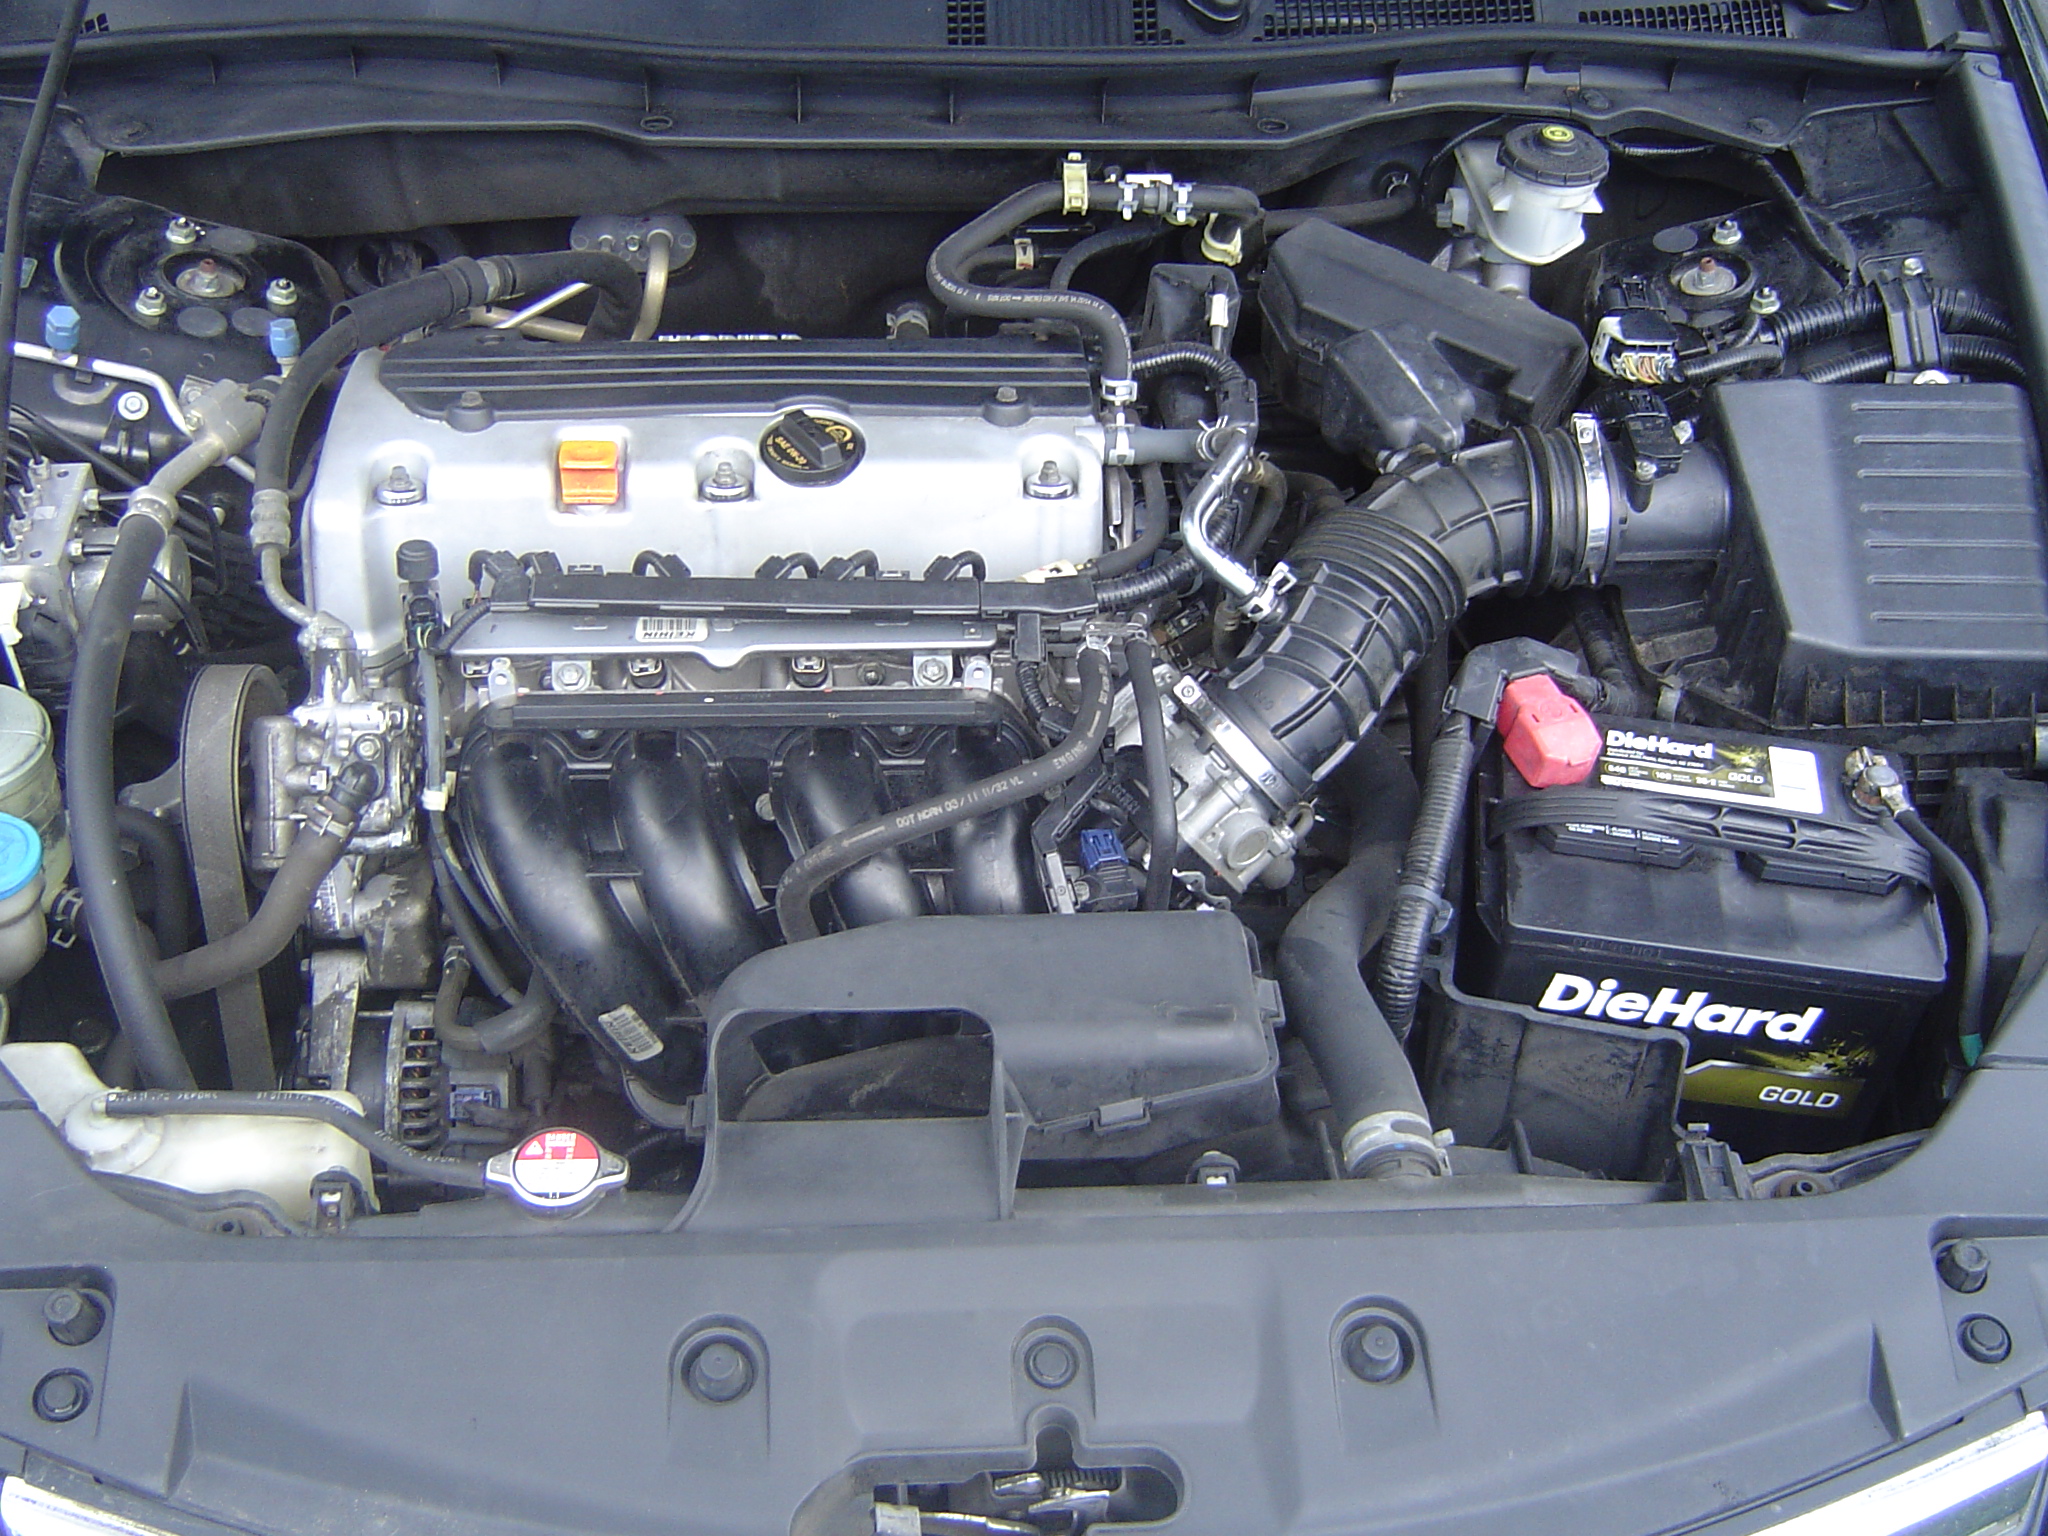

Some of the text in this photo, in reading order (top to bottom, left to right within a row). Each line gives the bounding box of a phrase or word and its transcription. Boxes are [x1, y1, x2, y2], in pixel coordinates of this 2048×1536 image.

[1053, 739, 1089, 770] ENGINE
[1606, 729, 1714, 760] DieHard
[1727, 772, 1765, 785] GOLD
[896, 814, 916, 829] DOT
[1009, 775, 1024, 786] VL
[1538, 972, 1825, 1043] DieHard
[1758, 1085, 1841, 1109] GOLD
